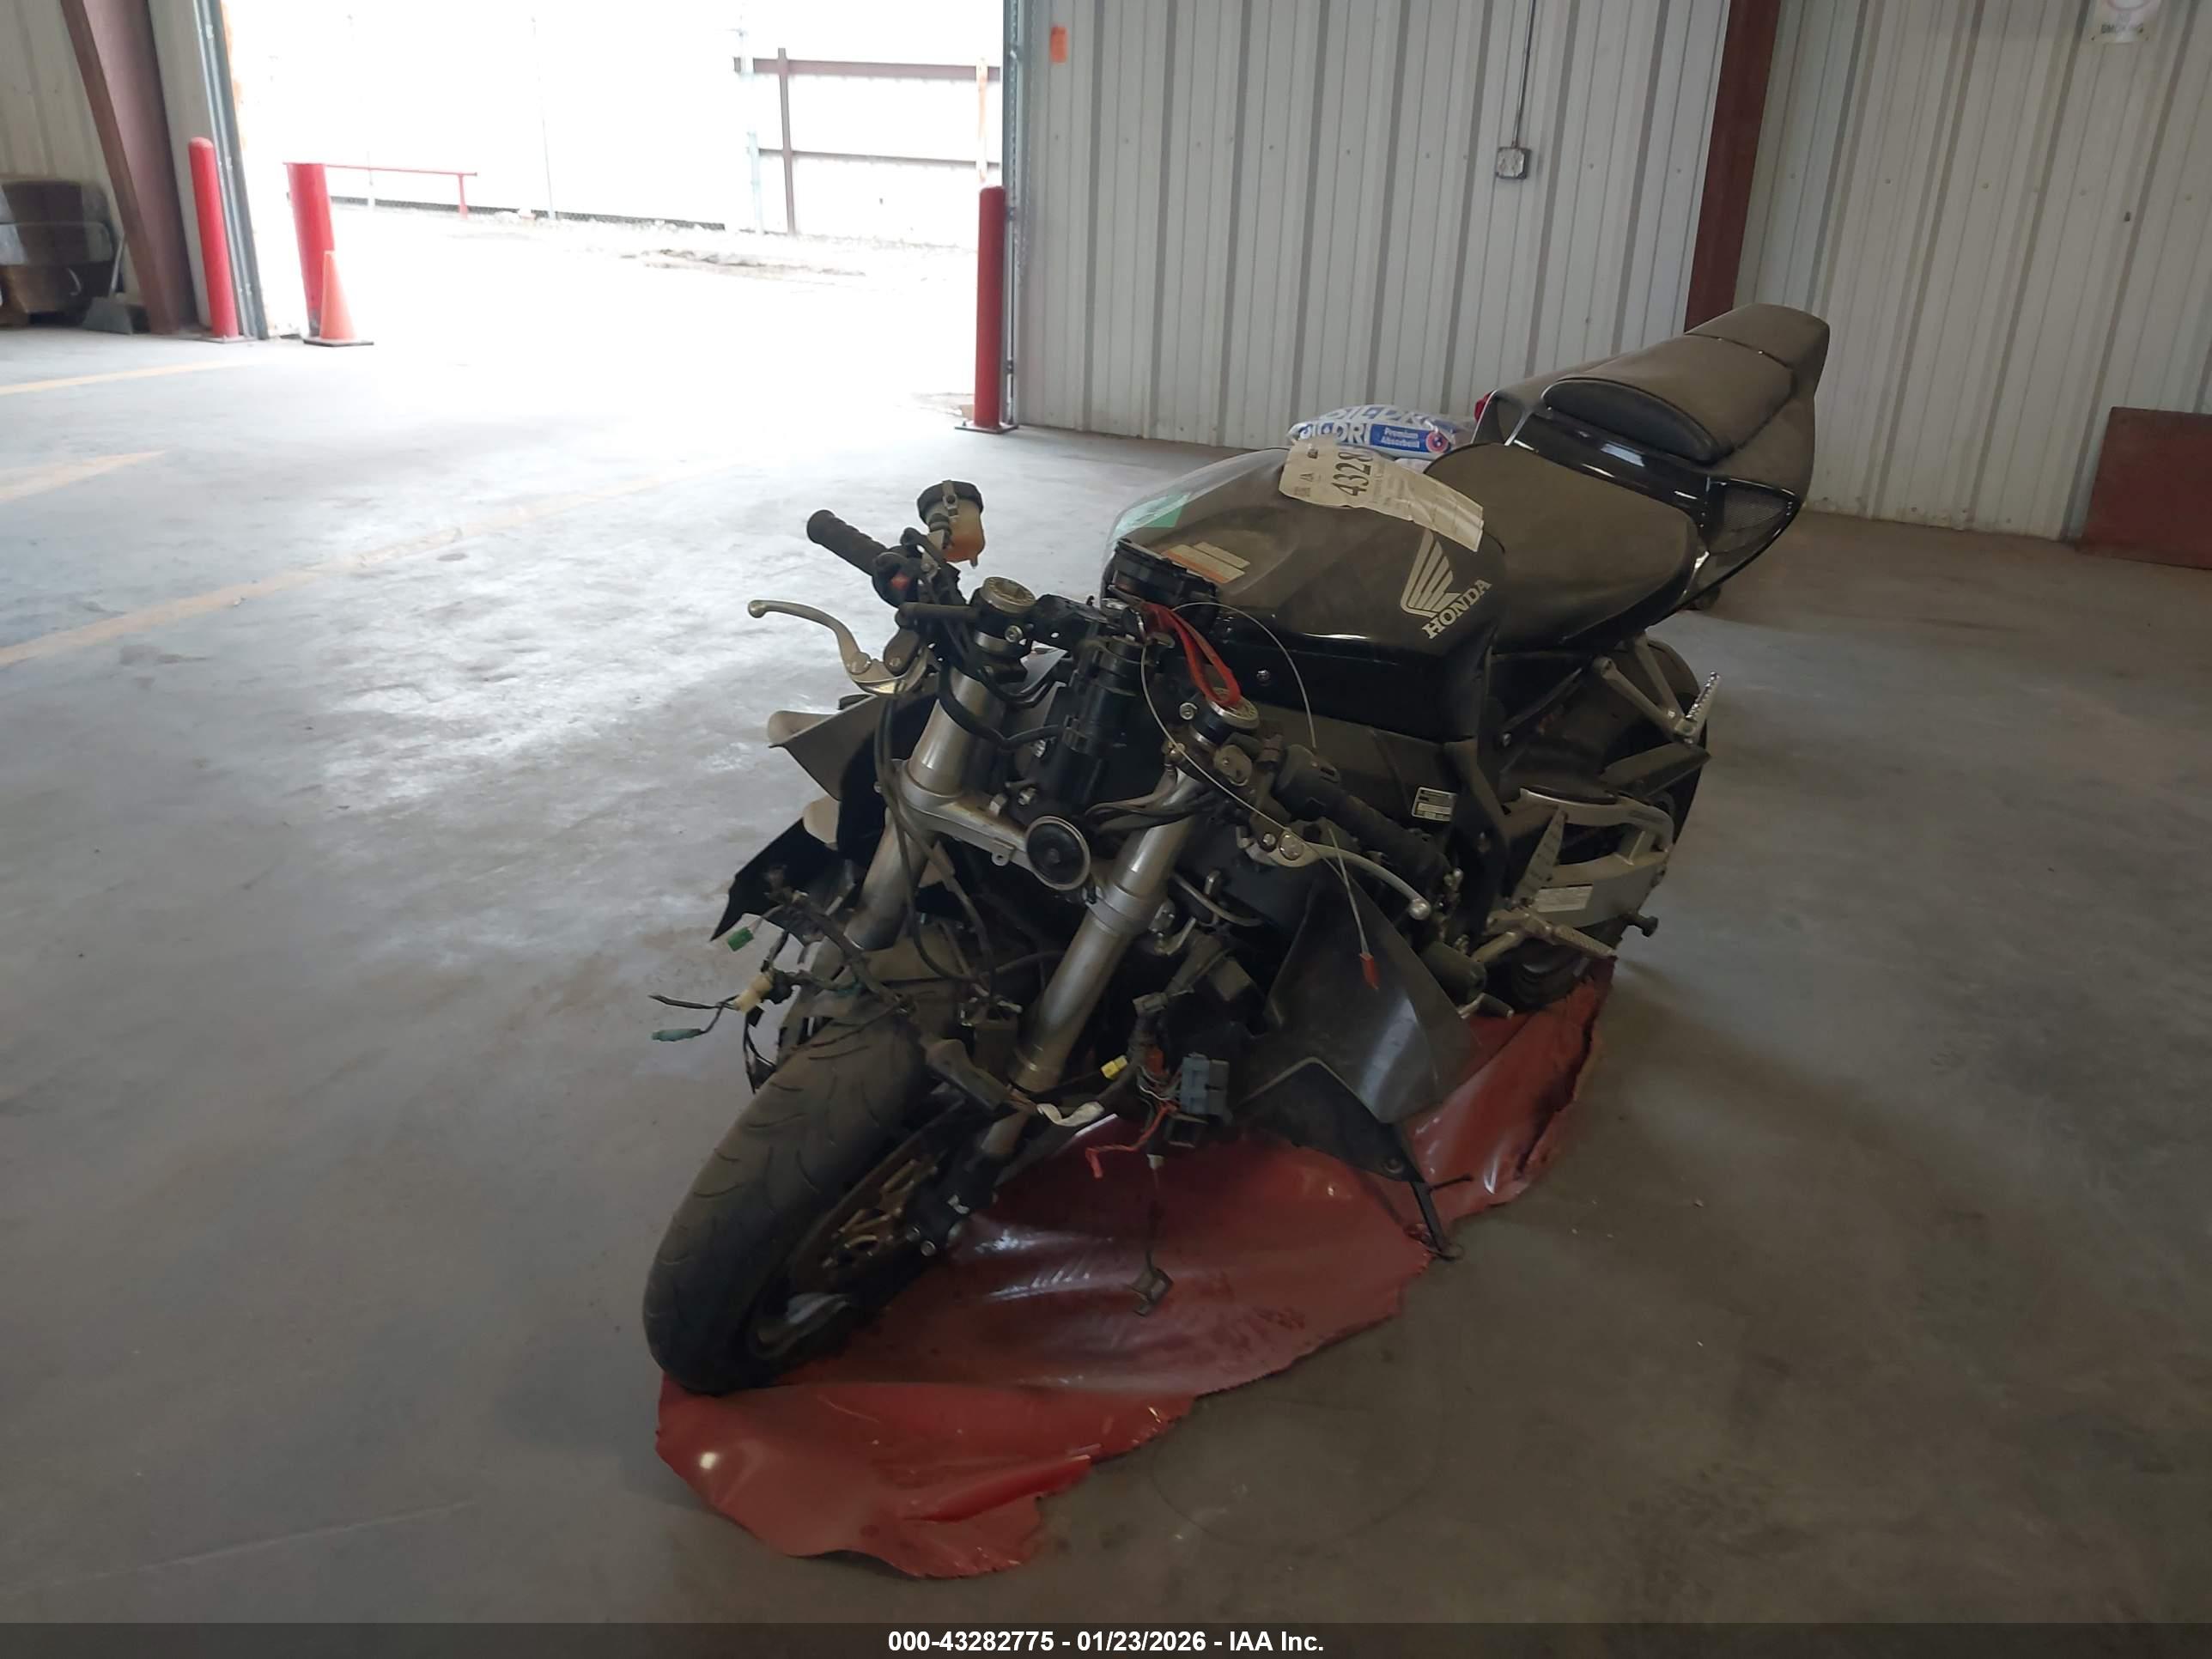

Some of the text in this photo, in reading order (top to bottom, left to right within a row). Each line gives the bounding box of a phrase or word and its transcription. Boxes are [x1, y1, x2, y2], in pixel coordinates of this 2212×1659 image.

[2101, 22, 2144, 34] SMOKG
[1384, 427, 1419, 440] Premium
[1381, 435, 1420, 448] Absorbent
[1331, 452, 1373, 496] 4328
[1422, 579, 1492, 640] HONDA
